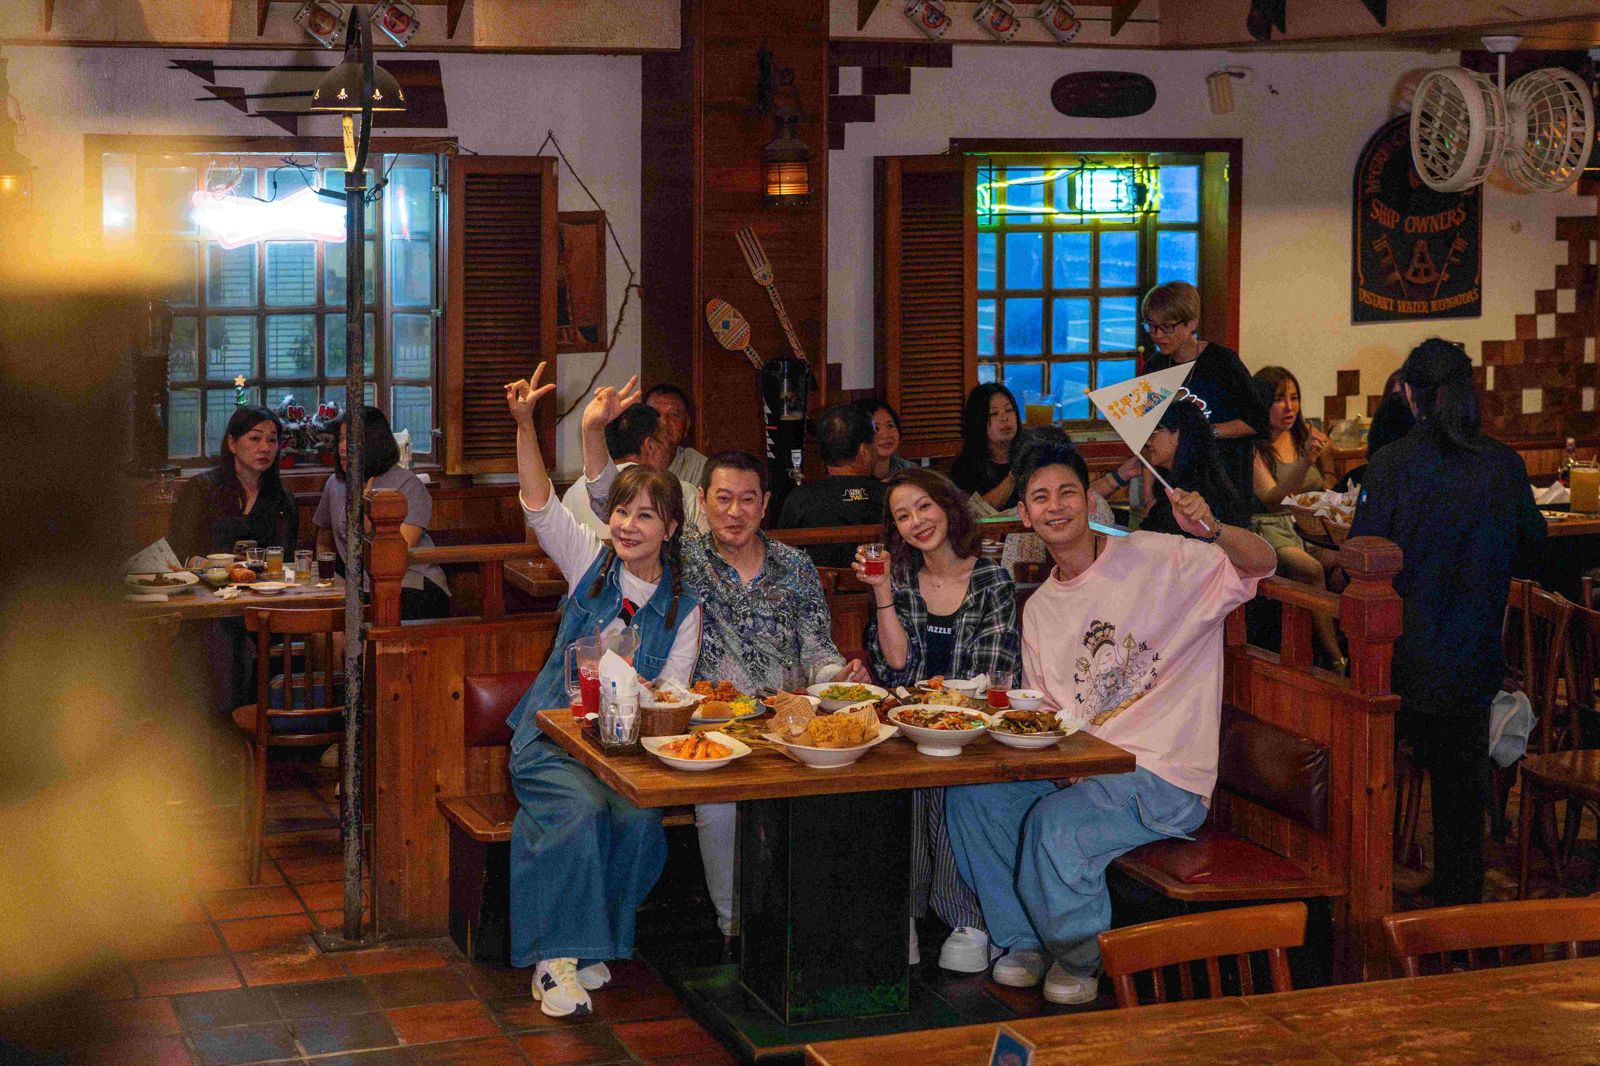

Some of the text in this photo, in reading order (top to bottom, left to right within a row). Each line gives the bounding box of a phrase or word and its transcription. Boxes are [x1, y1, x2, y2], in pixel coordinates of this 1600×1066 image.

[1370, 200, 1467, 235] SHIP OWNERS
[1358, 286, 1395, 311] DISTANT
[1397, 298, 1428, 314] WATER
[926, 625, 952, 635] AZZLE
